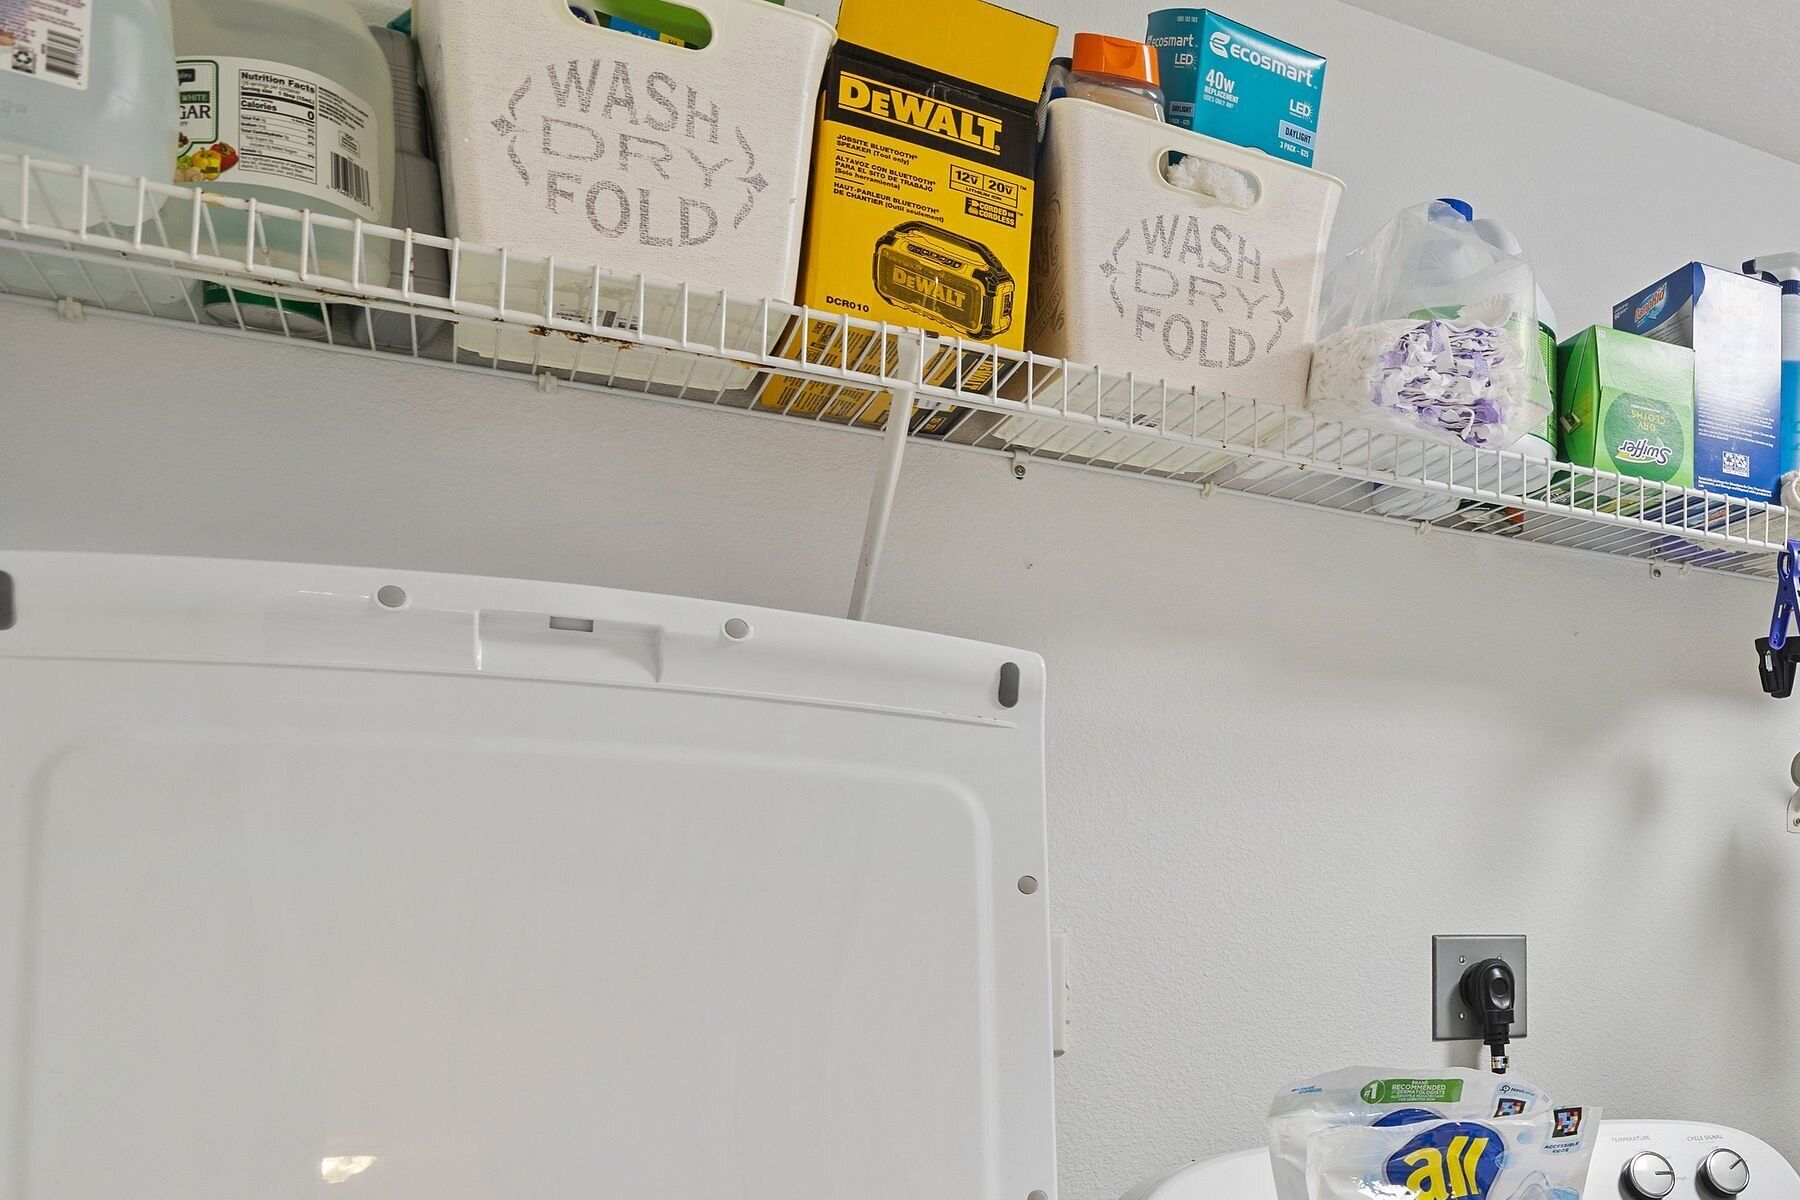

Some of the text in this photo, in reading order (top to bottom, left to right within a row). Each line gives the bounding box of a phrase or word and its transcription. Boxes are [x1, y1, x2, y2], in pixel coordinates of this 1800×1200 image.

[1151, 33, 1194, 48] ecosmart
[1174, 53, 1194, 66] LED
[1230, 42, 1314, 88] ecosmart
[241, 71, 315, 94] Nutrition Facts
[181, 93, 209, 103] WHITE
[546, 59, 721, 145] WASH
[1204, 86, 1240, 104] REPLACEMENT
[240, 99, 278, 112] Calories
[307, 110, 315, 121] 0
[1171, 104, 1192, 115] DAYLIGHT
[1289, 98, 1311, 117] LED
[836, 134, 869, 148] JOBSITE
[1285, 127, 1312, 144] DAYLIGHT
[541, 115, 733, 190] DRY
[836, 140, 910, 166] SPEAKER (Tool only)
[1280, 141, 1284, 149] 3
[1284, 143, 1297, 153] PACK
[835, 154, 870, 169] ALTAVOZ
[871, 164, 887, 174] CON
[834, 167, 901, 190] (Solo herramienta)
[835, 161, 933, 193] PARA EL SITO DE TRABAJO
[833, 181, 891, 202] HAUT-PARLEUR
[545, 169, 719, 248] FOLD
[833, 188, 945, 223] DE CHANTIER (Outil seulement)
[979, 202, 1008, 217] CORDED
[978, 209, 1015, 226] CORDLESS
[1141, 213, 1264, 284] WASH
[1134, 260, 1270, 322] DRY
[826, 295, 870, 313] DCR010
[1134, 304, 1257, 369] FOLD
[1631, 410, 1665, 425] CLOTHS
[1638, 421, 1656, 432] DRY
[1618, 438, 1672, 465] Swiffer
[1363, 1083, 1378, 1101] #1
[1543, 1141, 1580, 1150] ACCESSIBLE
[1611, 1135, 1651, 1143] TEMPERATURE
